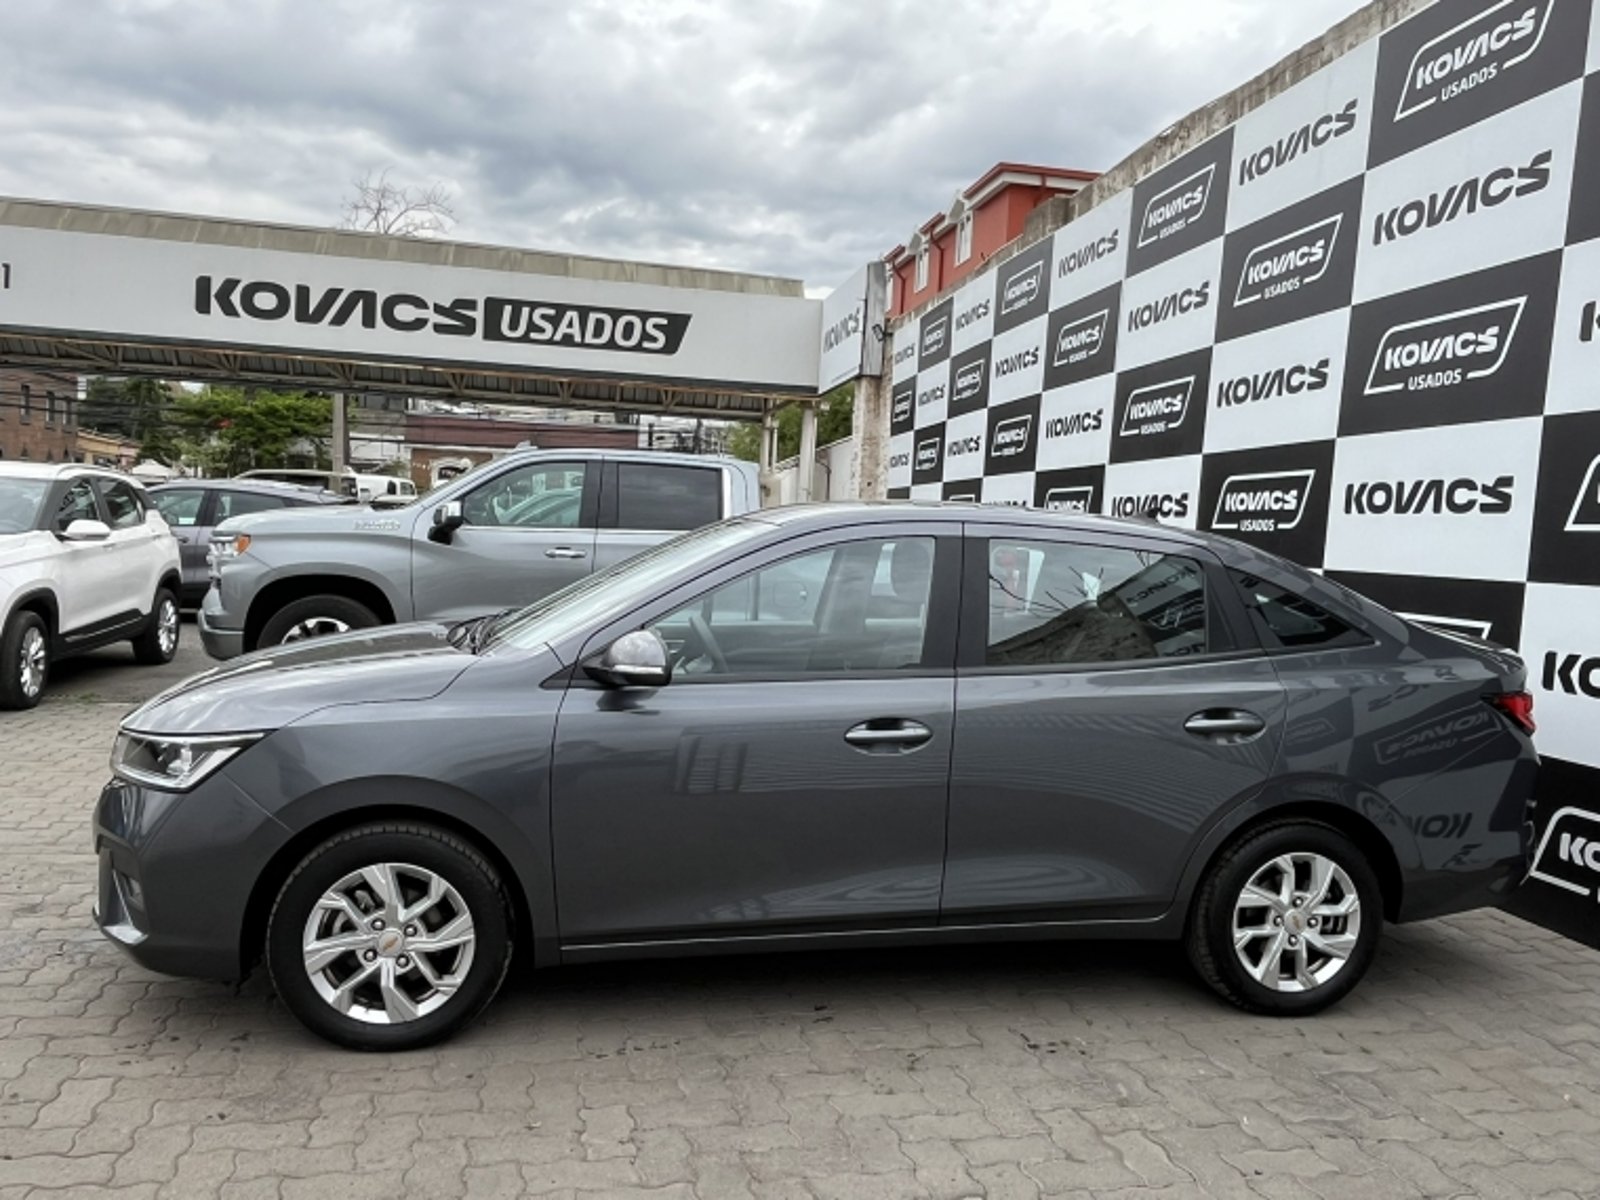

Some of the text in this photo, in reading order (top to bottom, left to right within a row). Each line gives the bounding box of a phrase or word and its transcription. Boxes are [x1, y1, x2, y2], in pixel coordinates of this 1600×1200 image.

[1416, 7, 1537, 89] KOVACS
[1441, 62, 1498, 101] USADOS
[1239, 99, 1358, 185] KOVACS
[1148, 185, 1203, 228] KOVACS
[1373, 150, 1553, 245] KOVACS
[1059, 229, 1119, 278] KOVACS
[1248, 239, 1325, 285] KOVACS
[195, 275, 669, 351] KOVACS USADOS
[1128, 281, 1209, 333] KOVACS
[1384, 325, 1500, 370] KOVACS
[1217, 358, 1330, 408] KOVACS
[1408, 368, 1462, 390] USADOS
[1046, 408, 1103, 439] KOVACS
[1130, 393, 1183, 420] KOVACS
[1225, 490, 1298, 512] KOVACS
[1345, 476, 1514, 514] KOVACS
